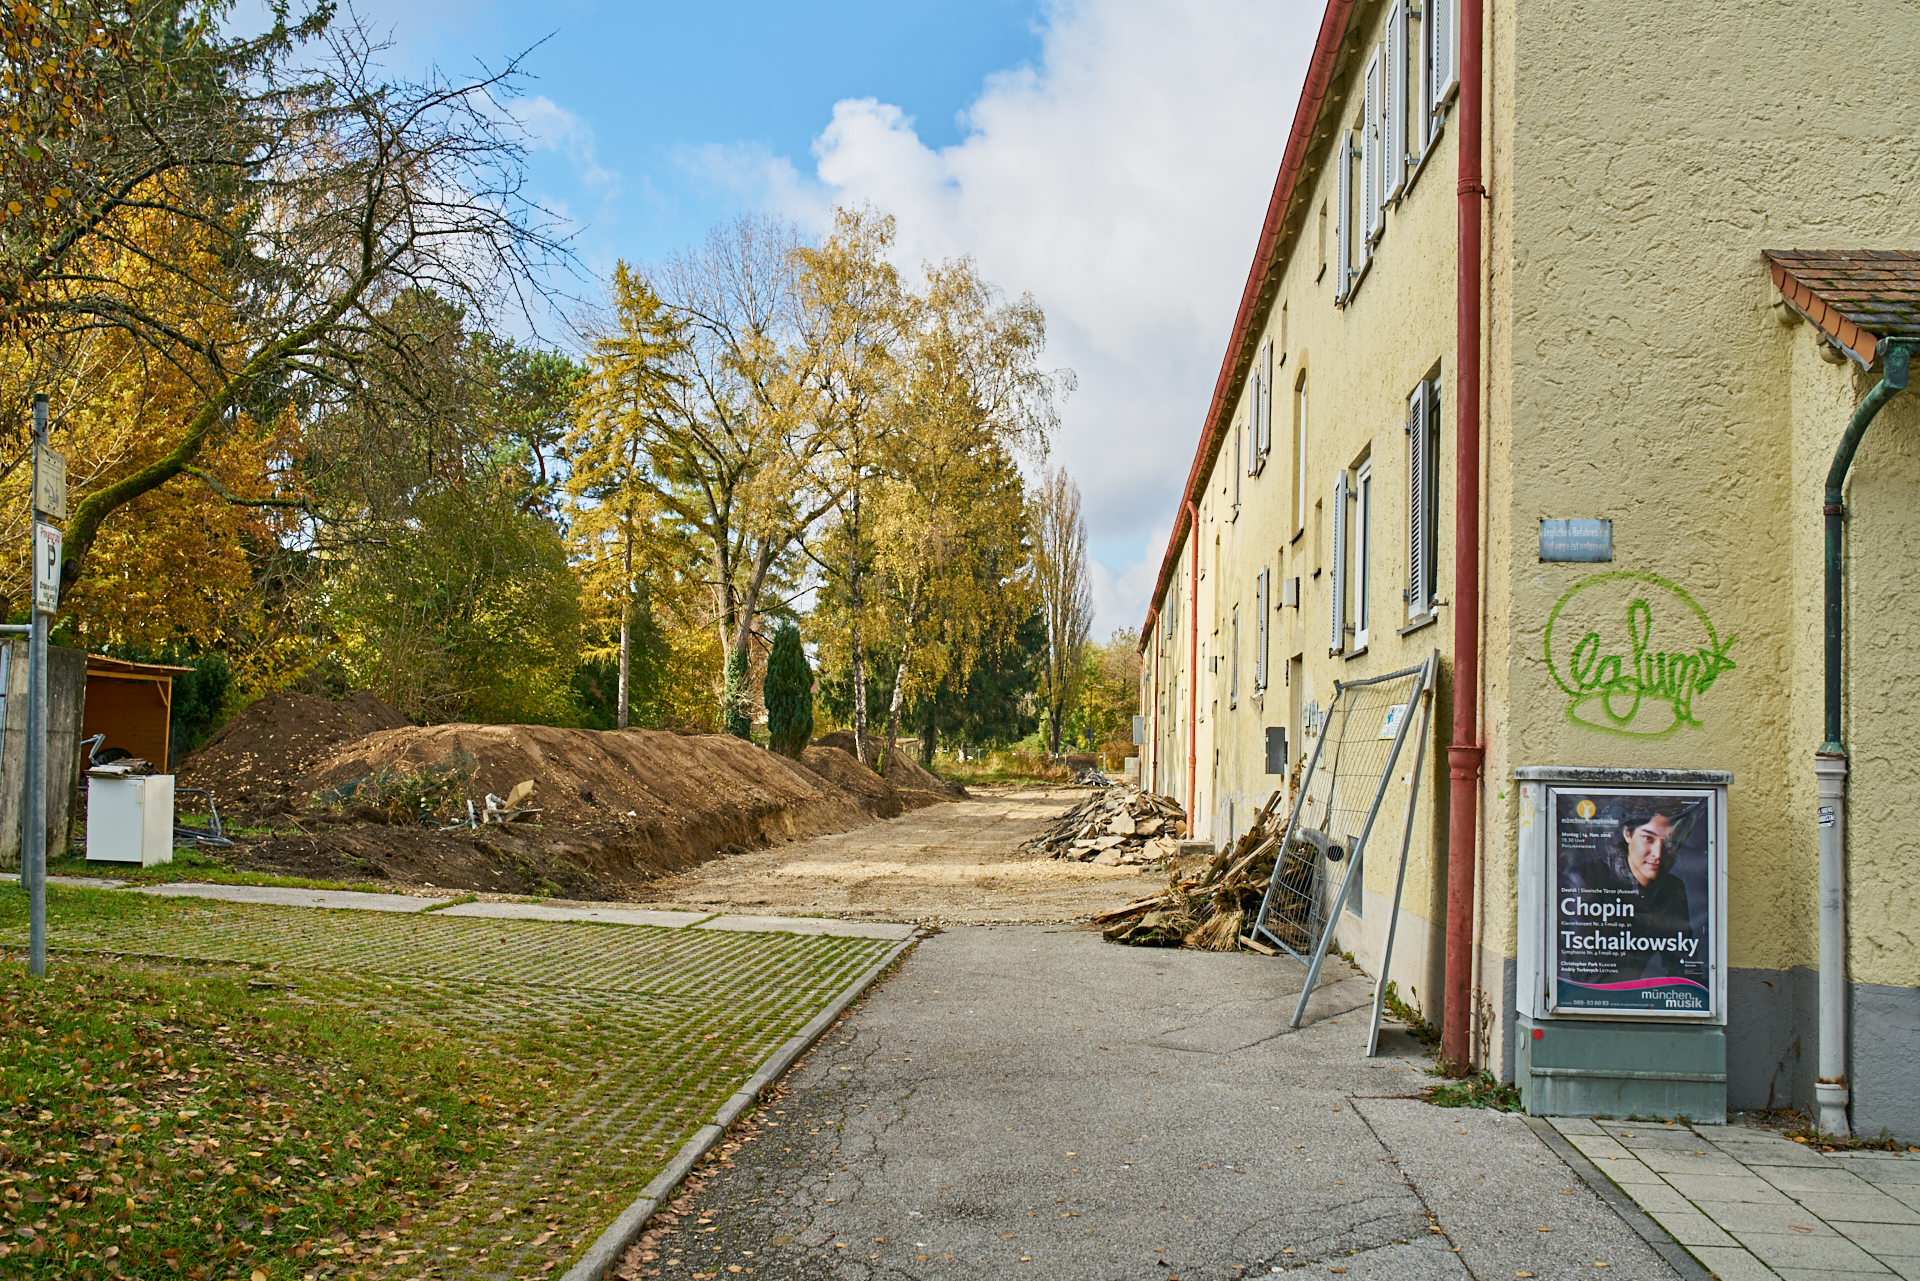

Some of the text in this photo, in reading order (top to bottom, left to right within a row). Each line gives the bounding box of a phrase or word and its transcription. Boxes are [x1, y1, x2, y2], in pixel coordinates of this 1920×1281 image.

[1543, 527, 1571, 539] Jegliches
[1573, 527, 1599, 537] Befahren
[1544, 541, 1570, 552] Hofwege
[1571, 541, 1579, 550] ist
[48, 545, 56, 579] P
[1560, 896, 1635, 922] Chopin
[1560, 930, 1699, 957] Tschaikowsky
[1641, 989, 1692, 1000] münchen
[1665, 997, 1703, 1008] musik
